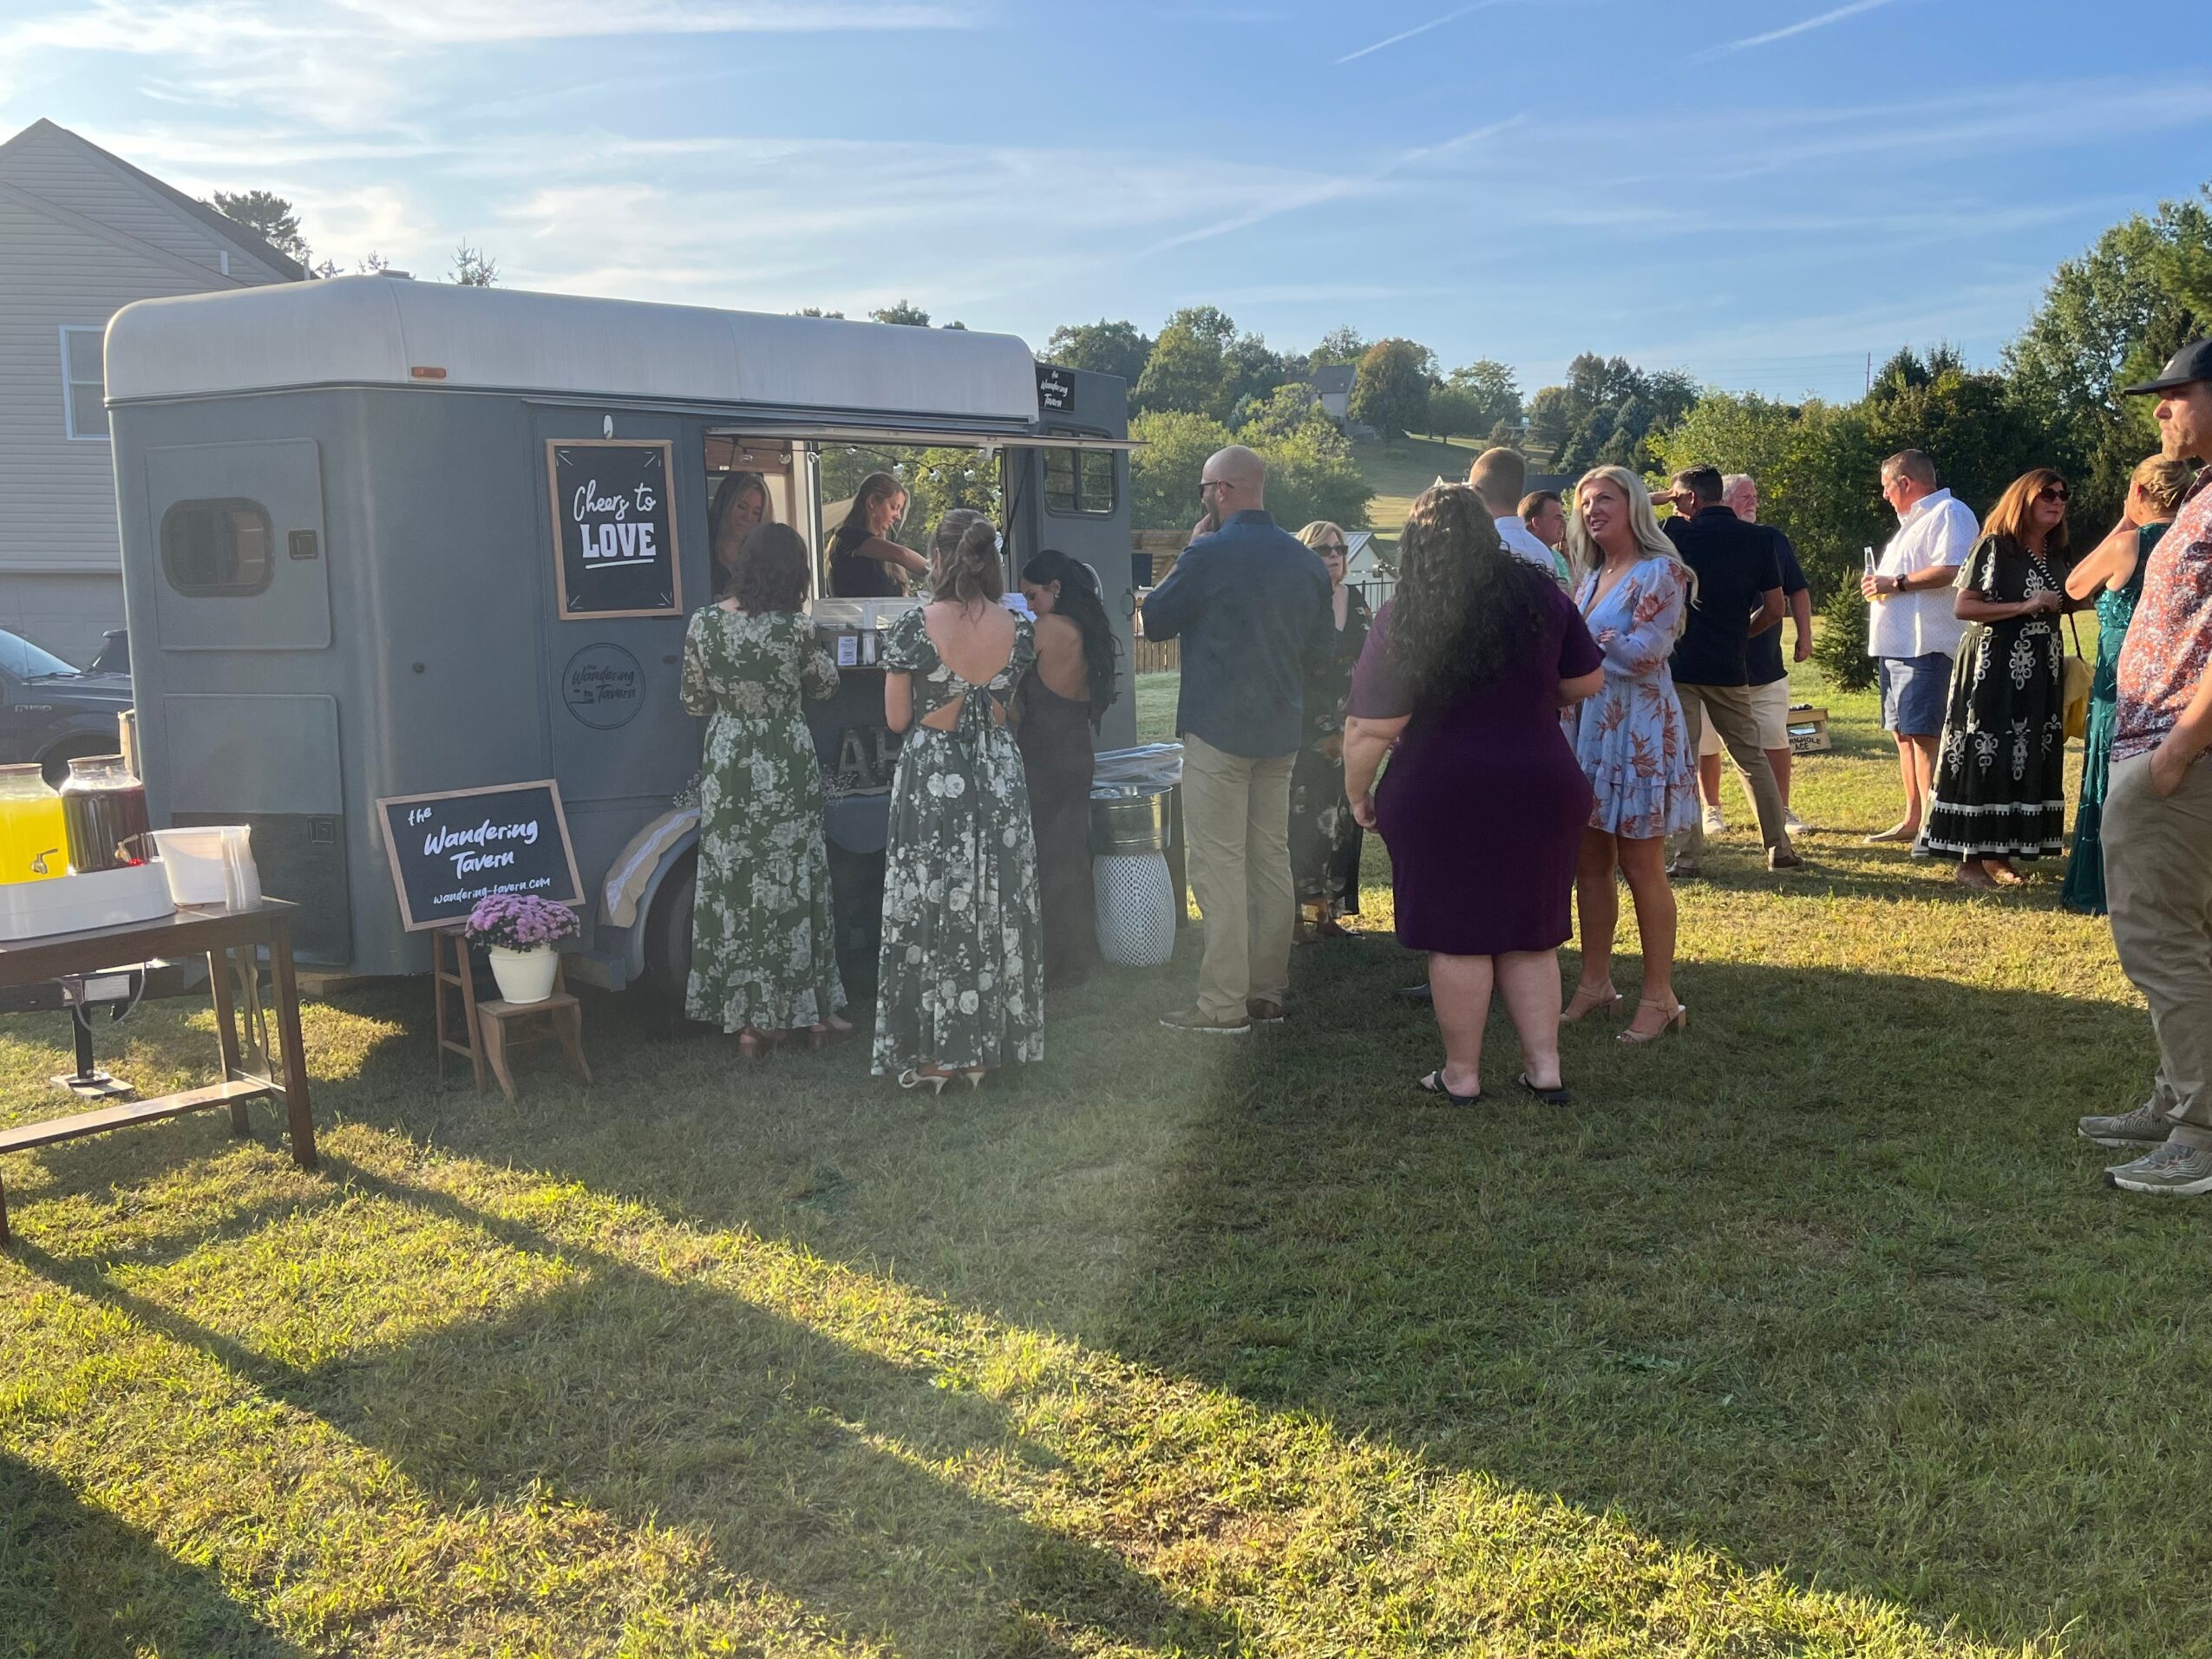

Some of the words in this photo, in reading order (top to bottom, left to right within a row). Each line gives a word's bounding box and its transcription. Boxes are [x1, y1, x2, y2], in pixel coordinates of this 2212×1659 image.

[573, 479, 630, 522] Cheers
[634, 482, 656, 513] to
[579, 522, 657, 558] LOVE
[571, 665, 635, 687] Wandering
[595, 683, 637, 704] Tavern
[407, 807, 433, 826] the
[423, 819, 538, 856] Wandering
[449, 850, 514, 880] Tavern
